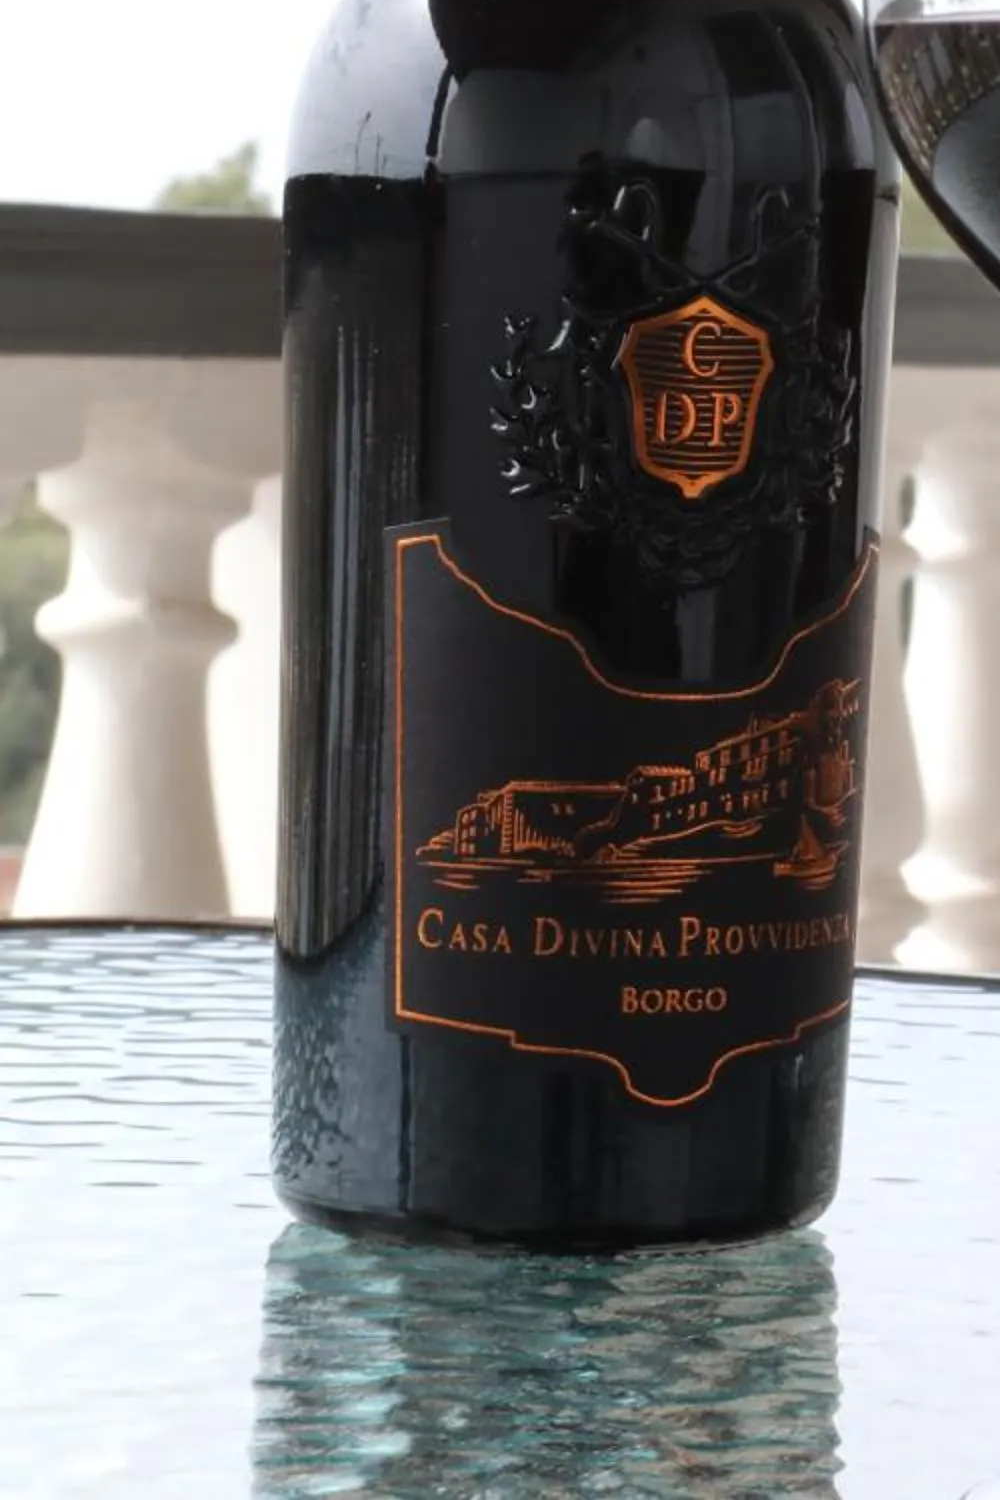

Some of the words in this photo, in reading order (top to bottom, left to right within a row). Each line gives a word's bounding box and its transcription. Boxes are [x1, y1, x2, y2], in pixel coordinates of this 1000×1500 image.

[685, 321, 722, 377] C
[417, 908, 512, 955] CASA
[533, 916, 667, 959] DIVINA
[620, 986, 728, 1014] BORGO
